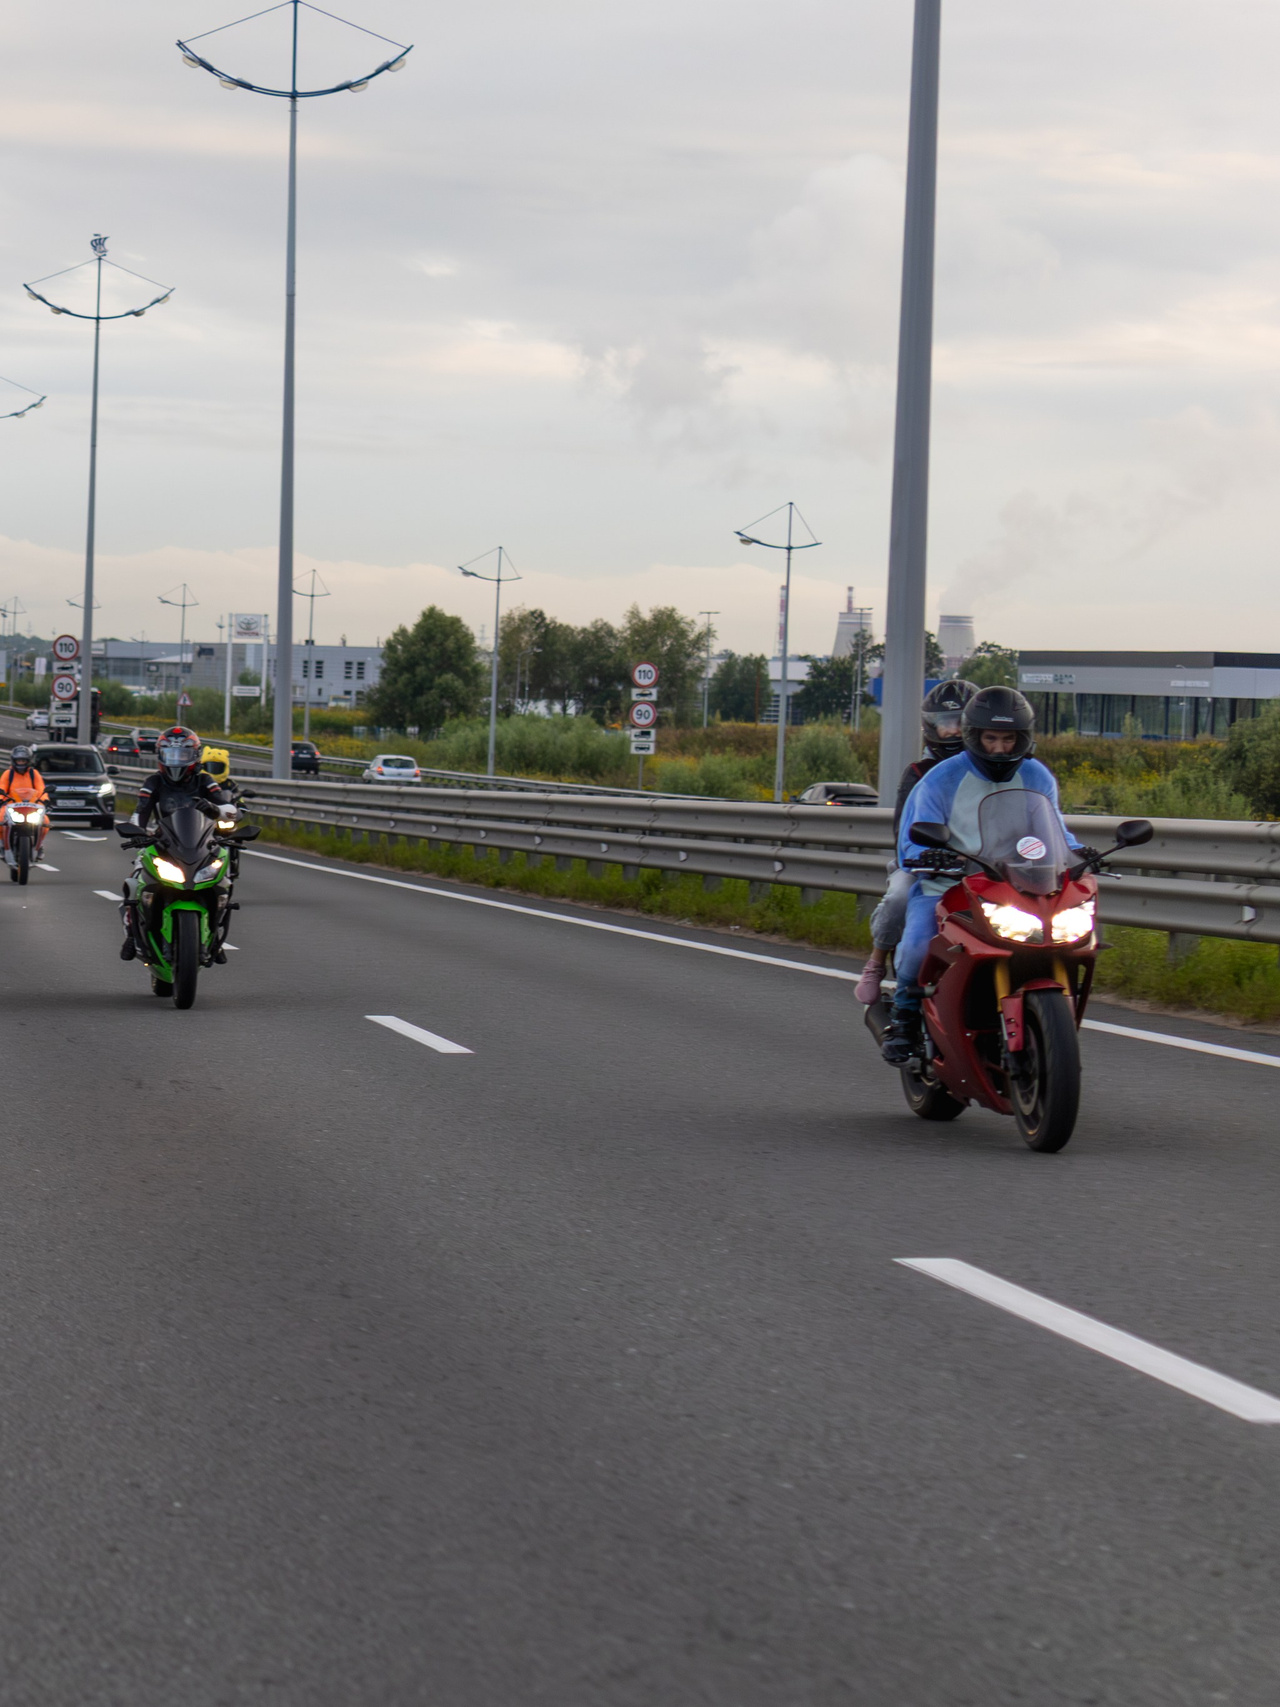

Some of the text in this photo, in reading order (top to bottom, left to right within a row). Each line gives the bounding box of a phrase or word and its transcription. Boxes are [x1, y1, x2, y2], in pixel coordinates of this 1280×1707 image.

[58, 642, 75, 653] 110
[638, 669, 654, 680] 110
[57, 682, 72, 693] 90
[635, 709, 651, 720] 90
